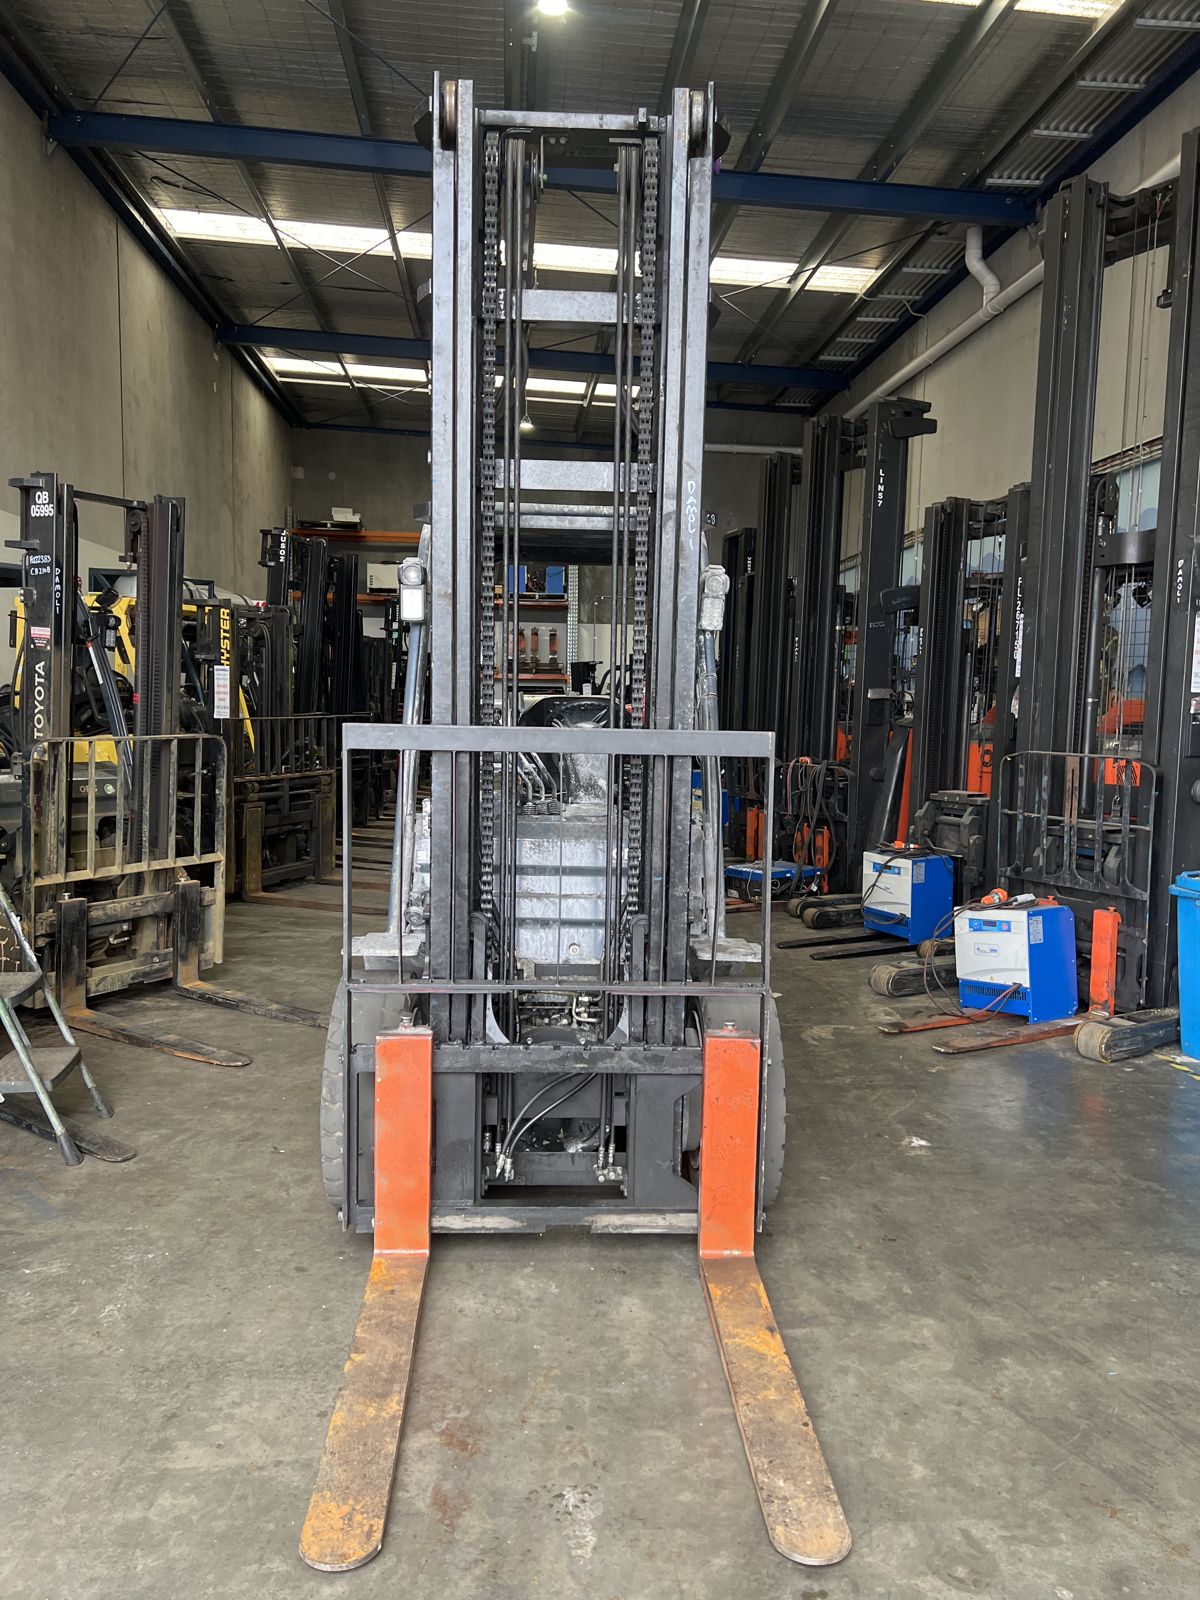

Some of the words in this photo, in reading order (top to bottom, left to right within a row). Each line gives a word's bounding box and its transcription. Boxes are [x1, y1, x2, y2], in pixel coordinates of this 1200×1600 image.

[35, 491, 49, 504] QB
[877, 468, 885, 507] LIN57
[30, 504, 54, 517] 05995
[33, 660, 46, 740] TOYOTA
